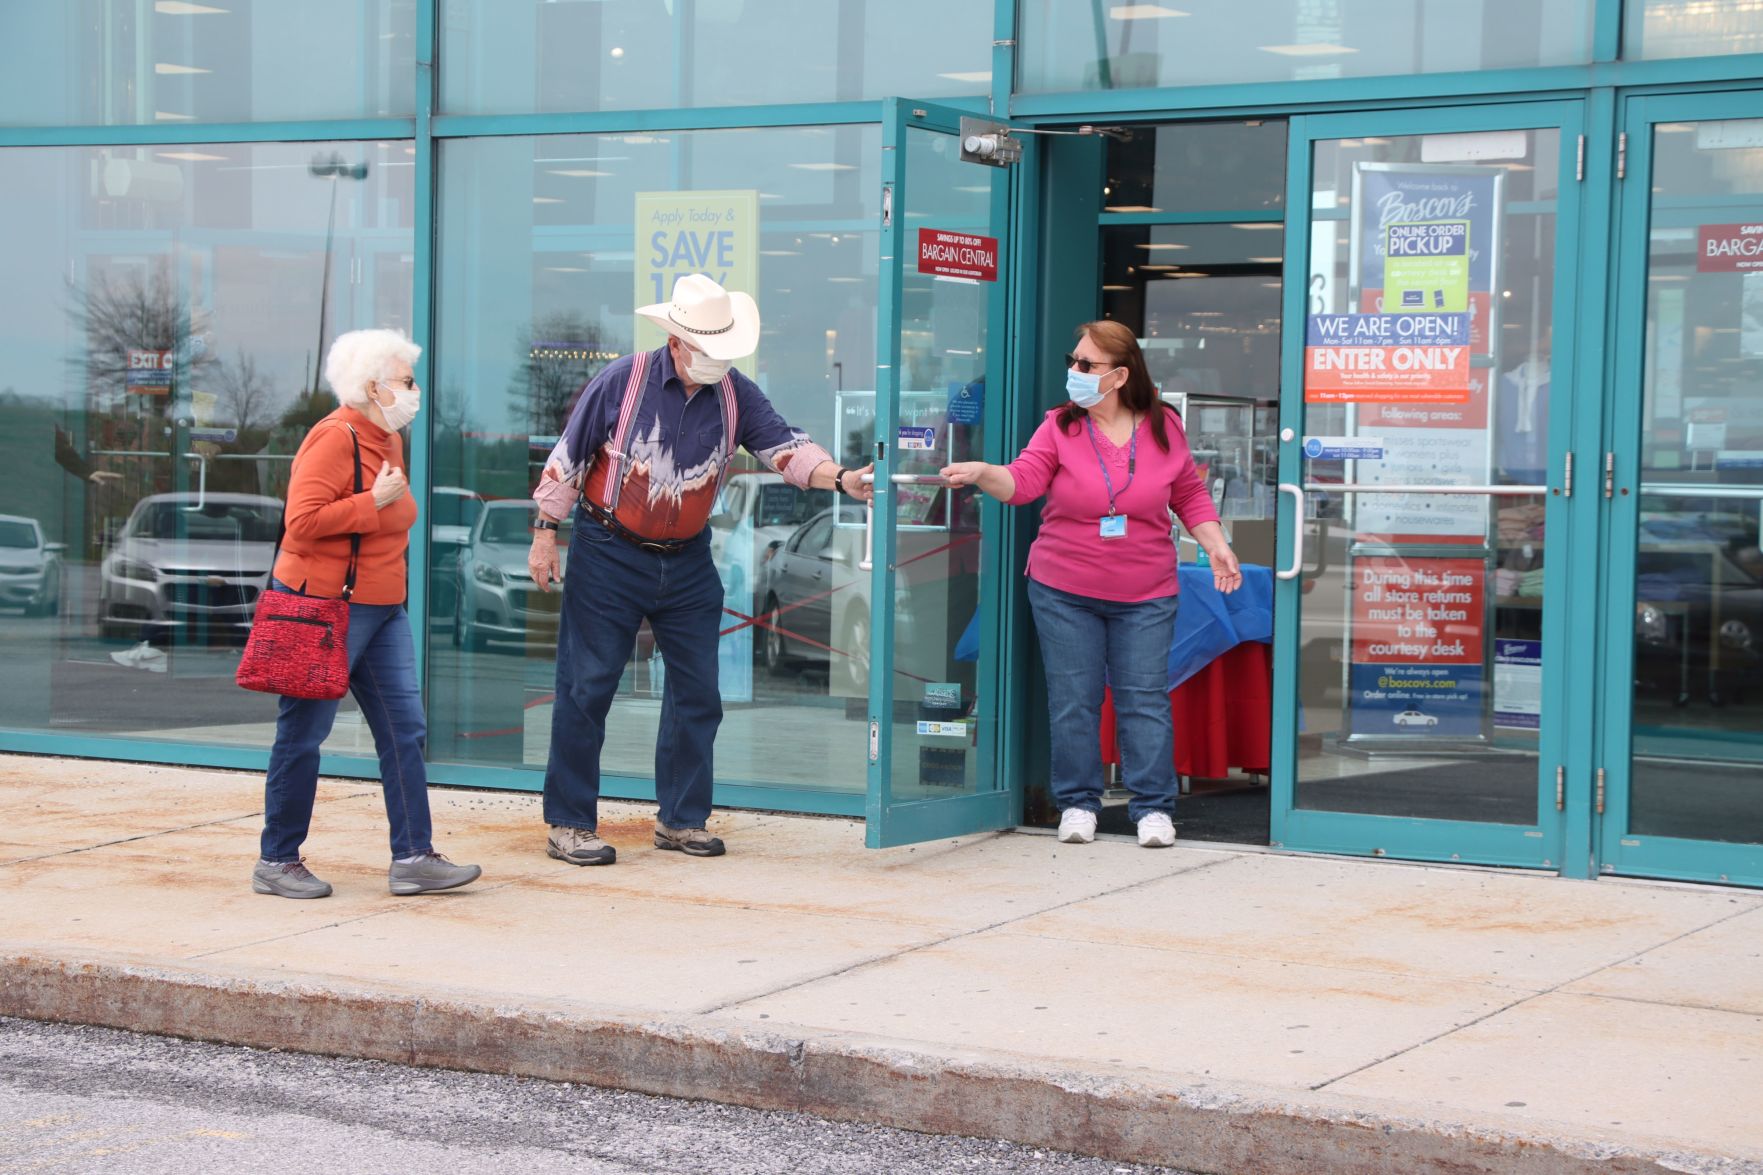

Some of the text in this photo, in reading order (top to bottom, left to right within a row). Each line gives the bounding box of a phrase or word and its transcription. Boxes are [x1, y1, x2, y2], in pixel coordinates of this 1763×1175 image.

[651, 208, 736, 225] Apply Today &
[936, 233, 954, 243] SAVINGS
[1389, 225, 1465, 237] ONLINE ORDER
[650, 230, 734, 268] SAVE
[922, 243, 994, 268] BARGAIN CENTRAL
[1317, 317, 1458, 335] WE ARE OPEN!
[131, 353, 160, 369] EXIT
[1313, 347, 1461, 371] ENTER ONLY
[1377, 372, 1393, 380] safety
[1381, 406, 1464, 422] following areas:
[1417, 438, 1472, 449] sportswear
[1395, 514, 1456, 525] housewares
[1363, 569, 1473, 589] During this time
[1363, 585, 1472, 603] all store returns
[1368, 604, 1466, 620] must be taken
[1397, 621, 1437, 637] to the
[1368, 639, 1464, 660] courtesy desk
[1384, 667, 1449, 677] We're always open
[1378, 676, 1456, 688] @boscovs.com
[1363, 690, 1386, 699] Order
